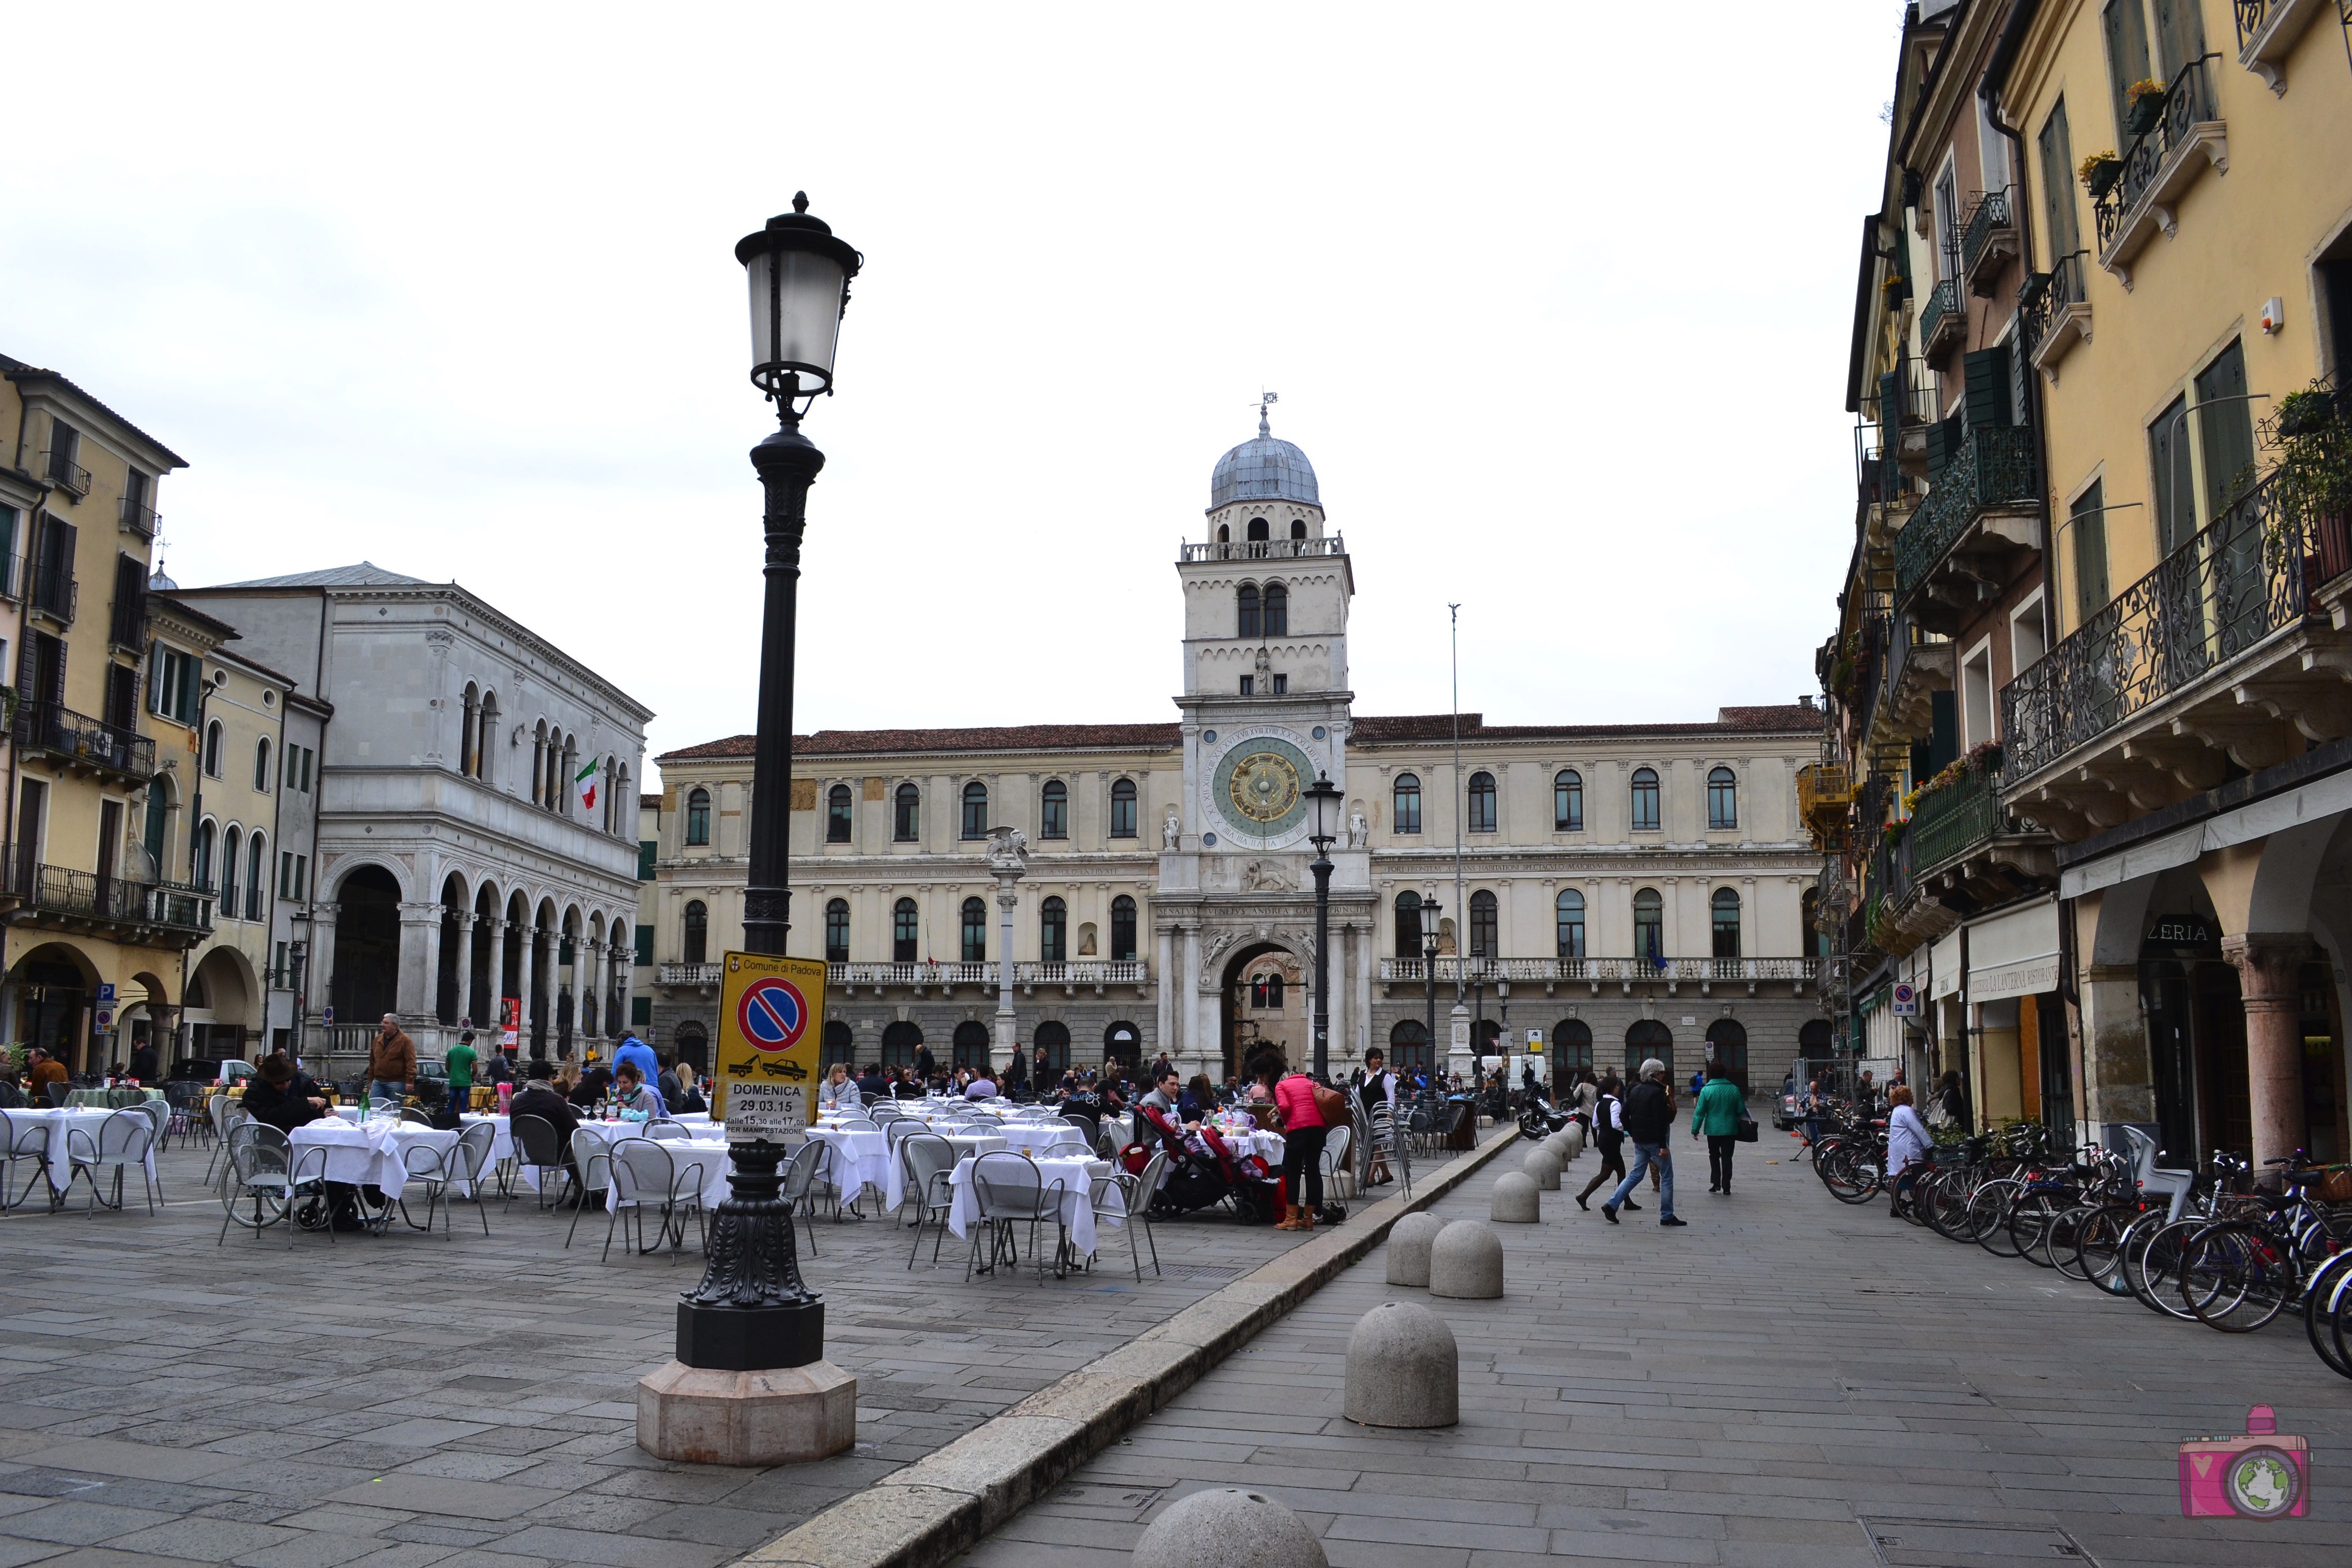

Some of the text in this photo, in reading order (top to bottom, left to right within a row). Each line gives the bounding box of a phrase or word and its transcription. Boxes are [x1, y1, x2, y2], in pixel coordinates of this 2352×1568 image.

[2147, 924, 2208, 940] ZERIA
[743, 959, 821, 976] Comune di Padova
[1997, 970, 2026, 991] LANTERNA
[100, 986, 111, 999] P
[733, 1084, 801, 1096] DOMENICA
[740, 1099, 792, 1112] 29.03.15
